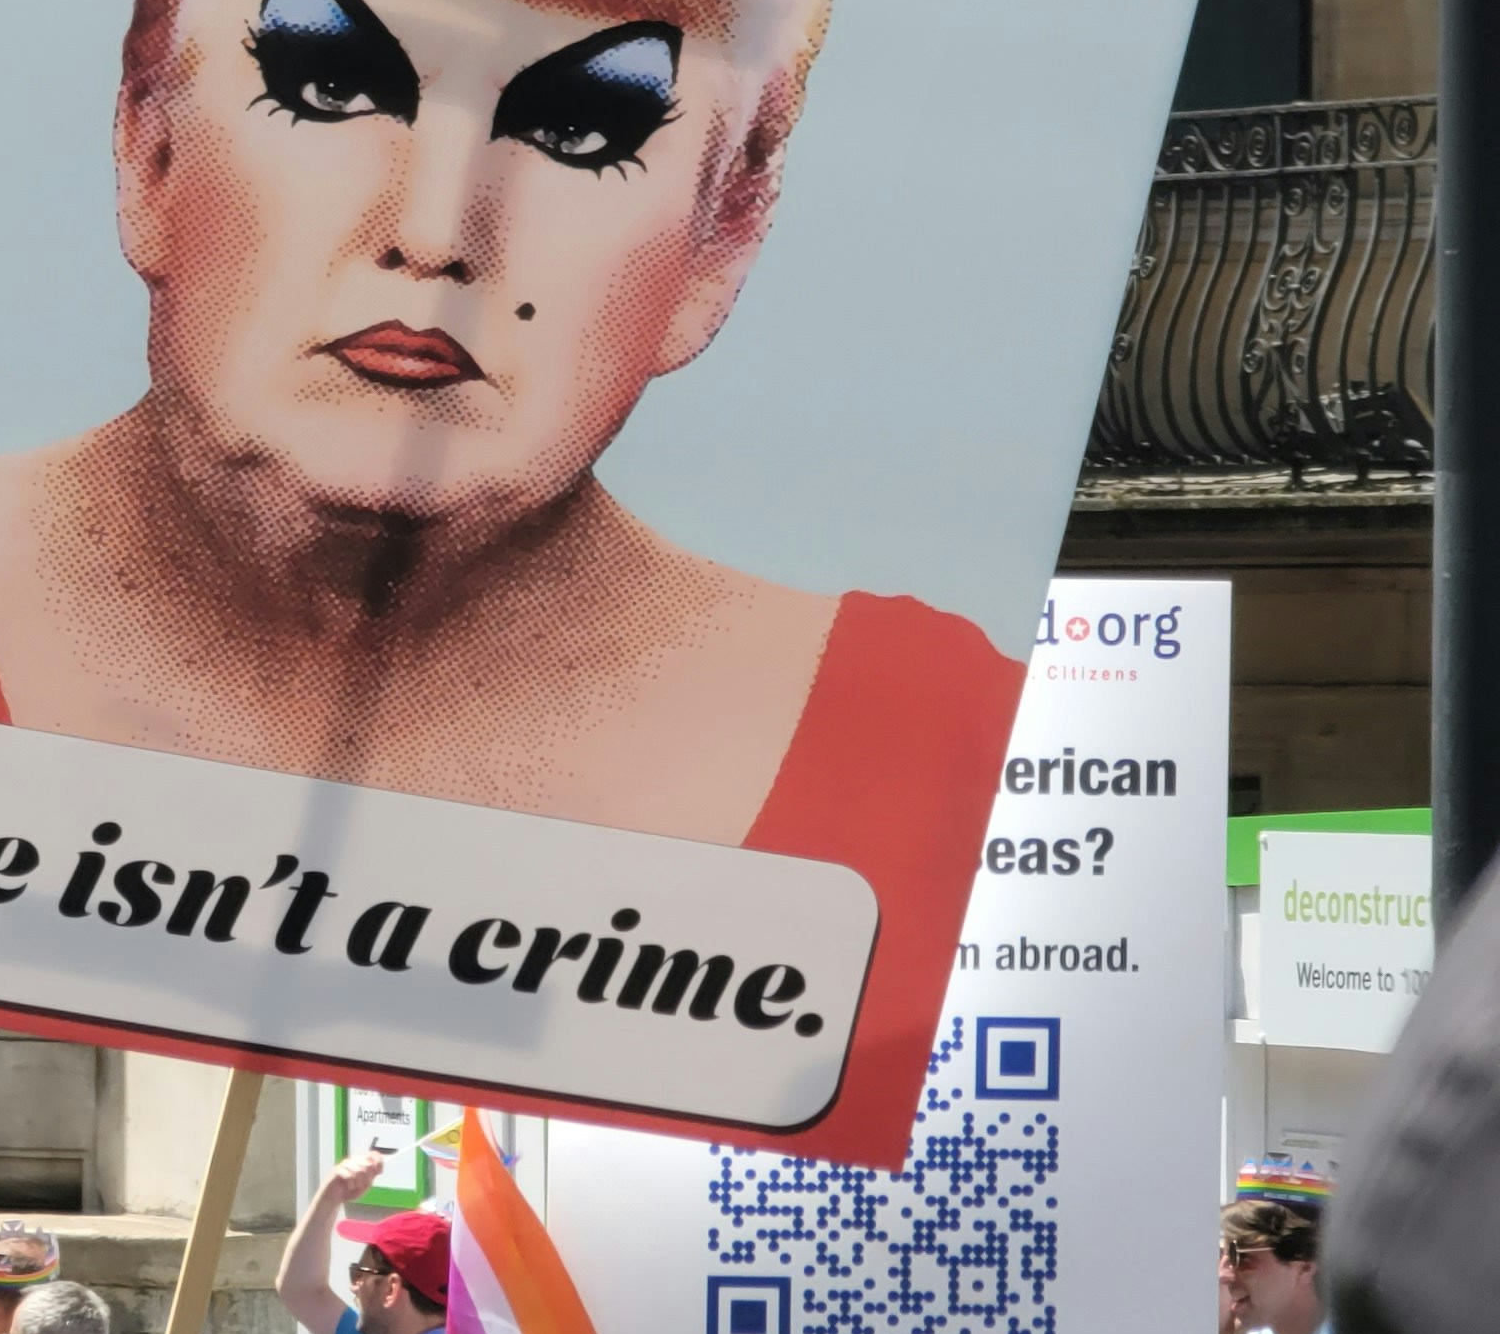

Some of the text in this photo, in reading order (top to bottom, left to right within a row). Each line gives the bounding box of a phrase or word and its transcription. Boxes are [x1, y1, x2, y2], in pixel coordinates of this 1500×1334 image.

[1047, 665, 1138, 682] Citizens
[999, 747, 1177, 796] erican
[1284, 879, 1431, 928] deconstruc
[58, 819, 339, 955] isn't
[346, 901, 432, 972] a
[447, 908, 825, 1038] crime.
[995, 936, 1139, 972] abroad.
[1296, 962, 1372, 991] Welcome
[1377, 967, 1396, 993] to
